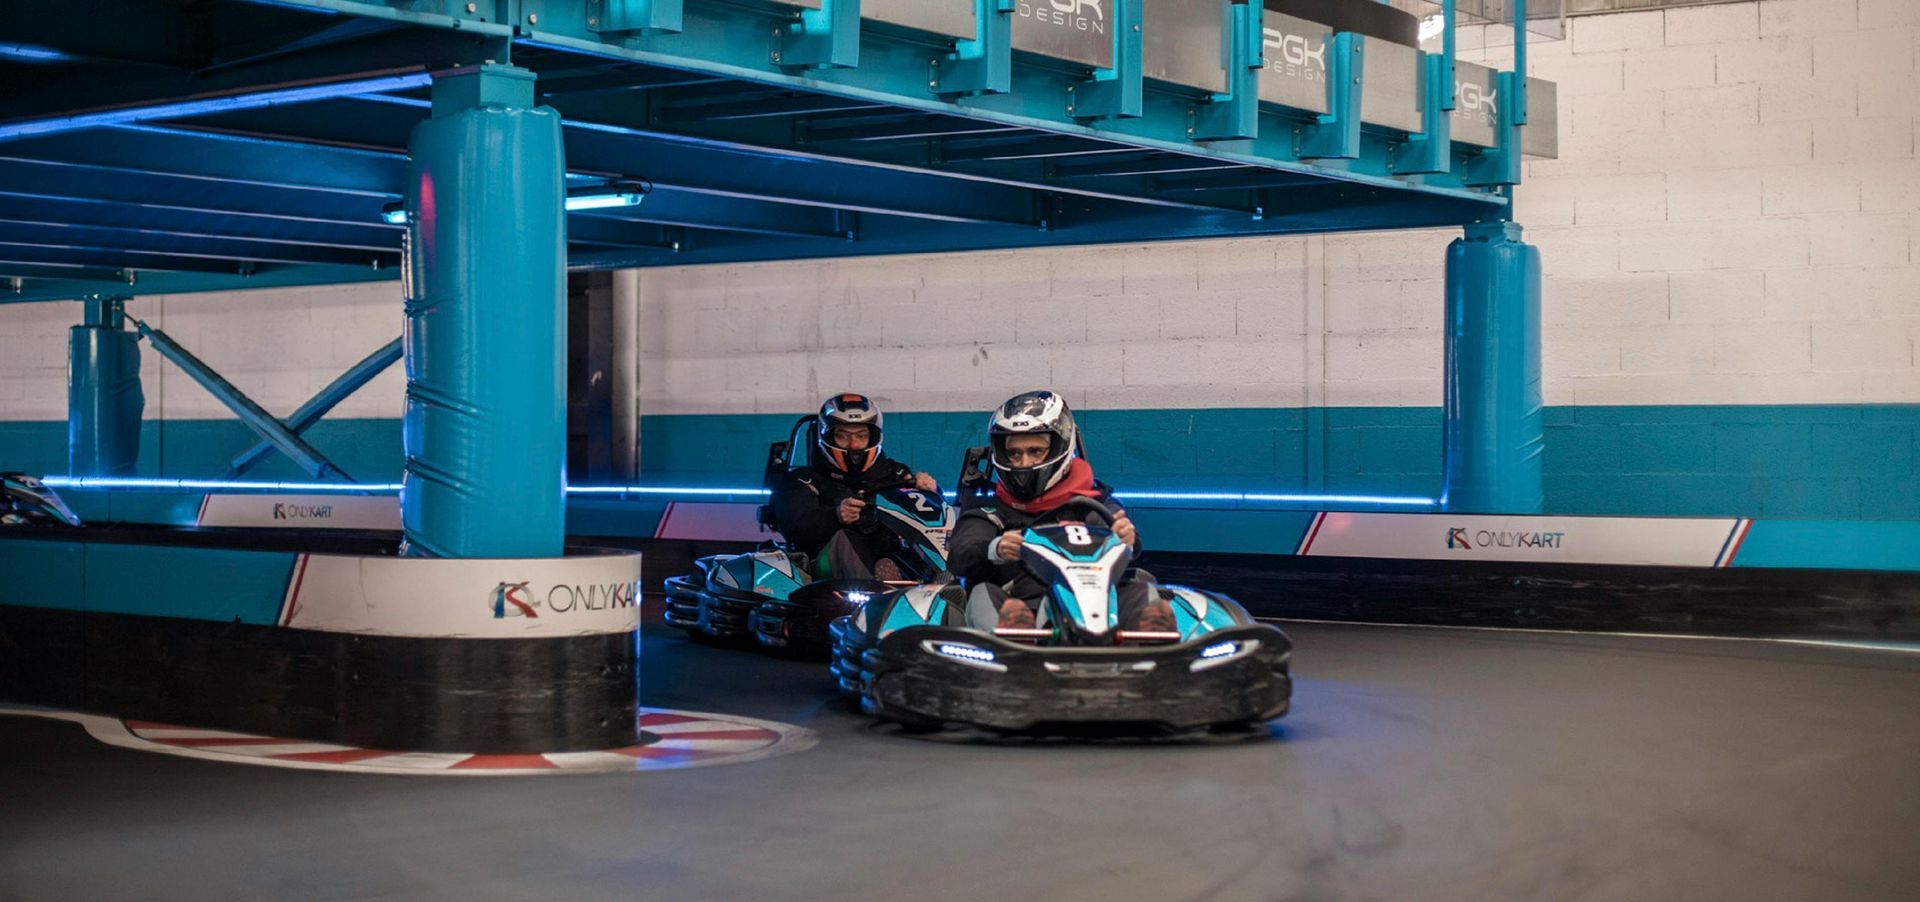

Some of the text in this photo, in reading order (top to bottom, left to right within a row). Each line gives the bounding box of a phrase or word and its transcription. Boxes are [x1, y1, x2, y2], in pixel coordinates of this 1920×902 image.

[1019, 3, 1104, 35] DESIGN
[1263, 28, 1326, 71] PGK
[1455, 106, 1497, 125] ESIGN
[288, 504, 333, 518] ONLYKART
[907, 492, 935, 512] 2
[1064, 525, 1093, 545] 8
[1476, 530, 1565, 549] ONLYKART
[548, 581, 642, 613] ONLYKA
